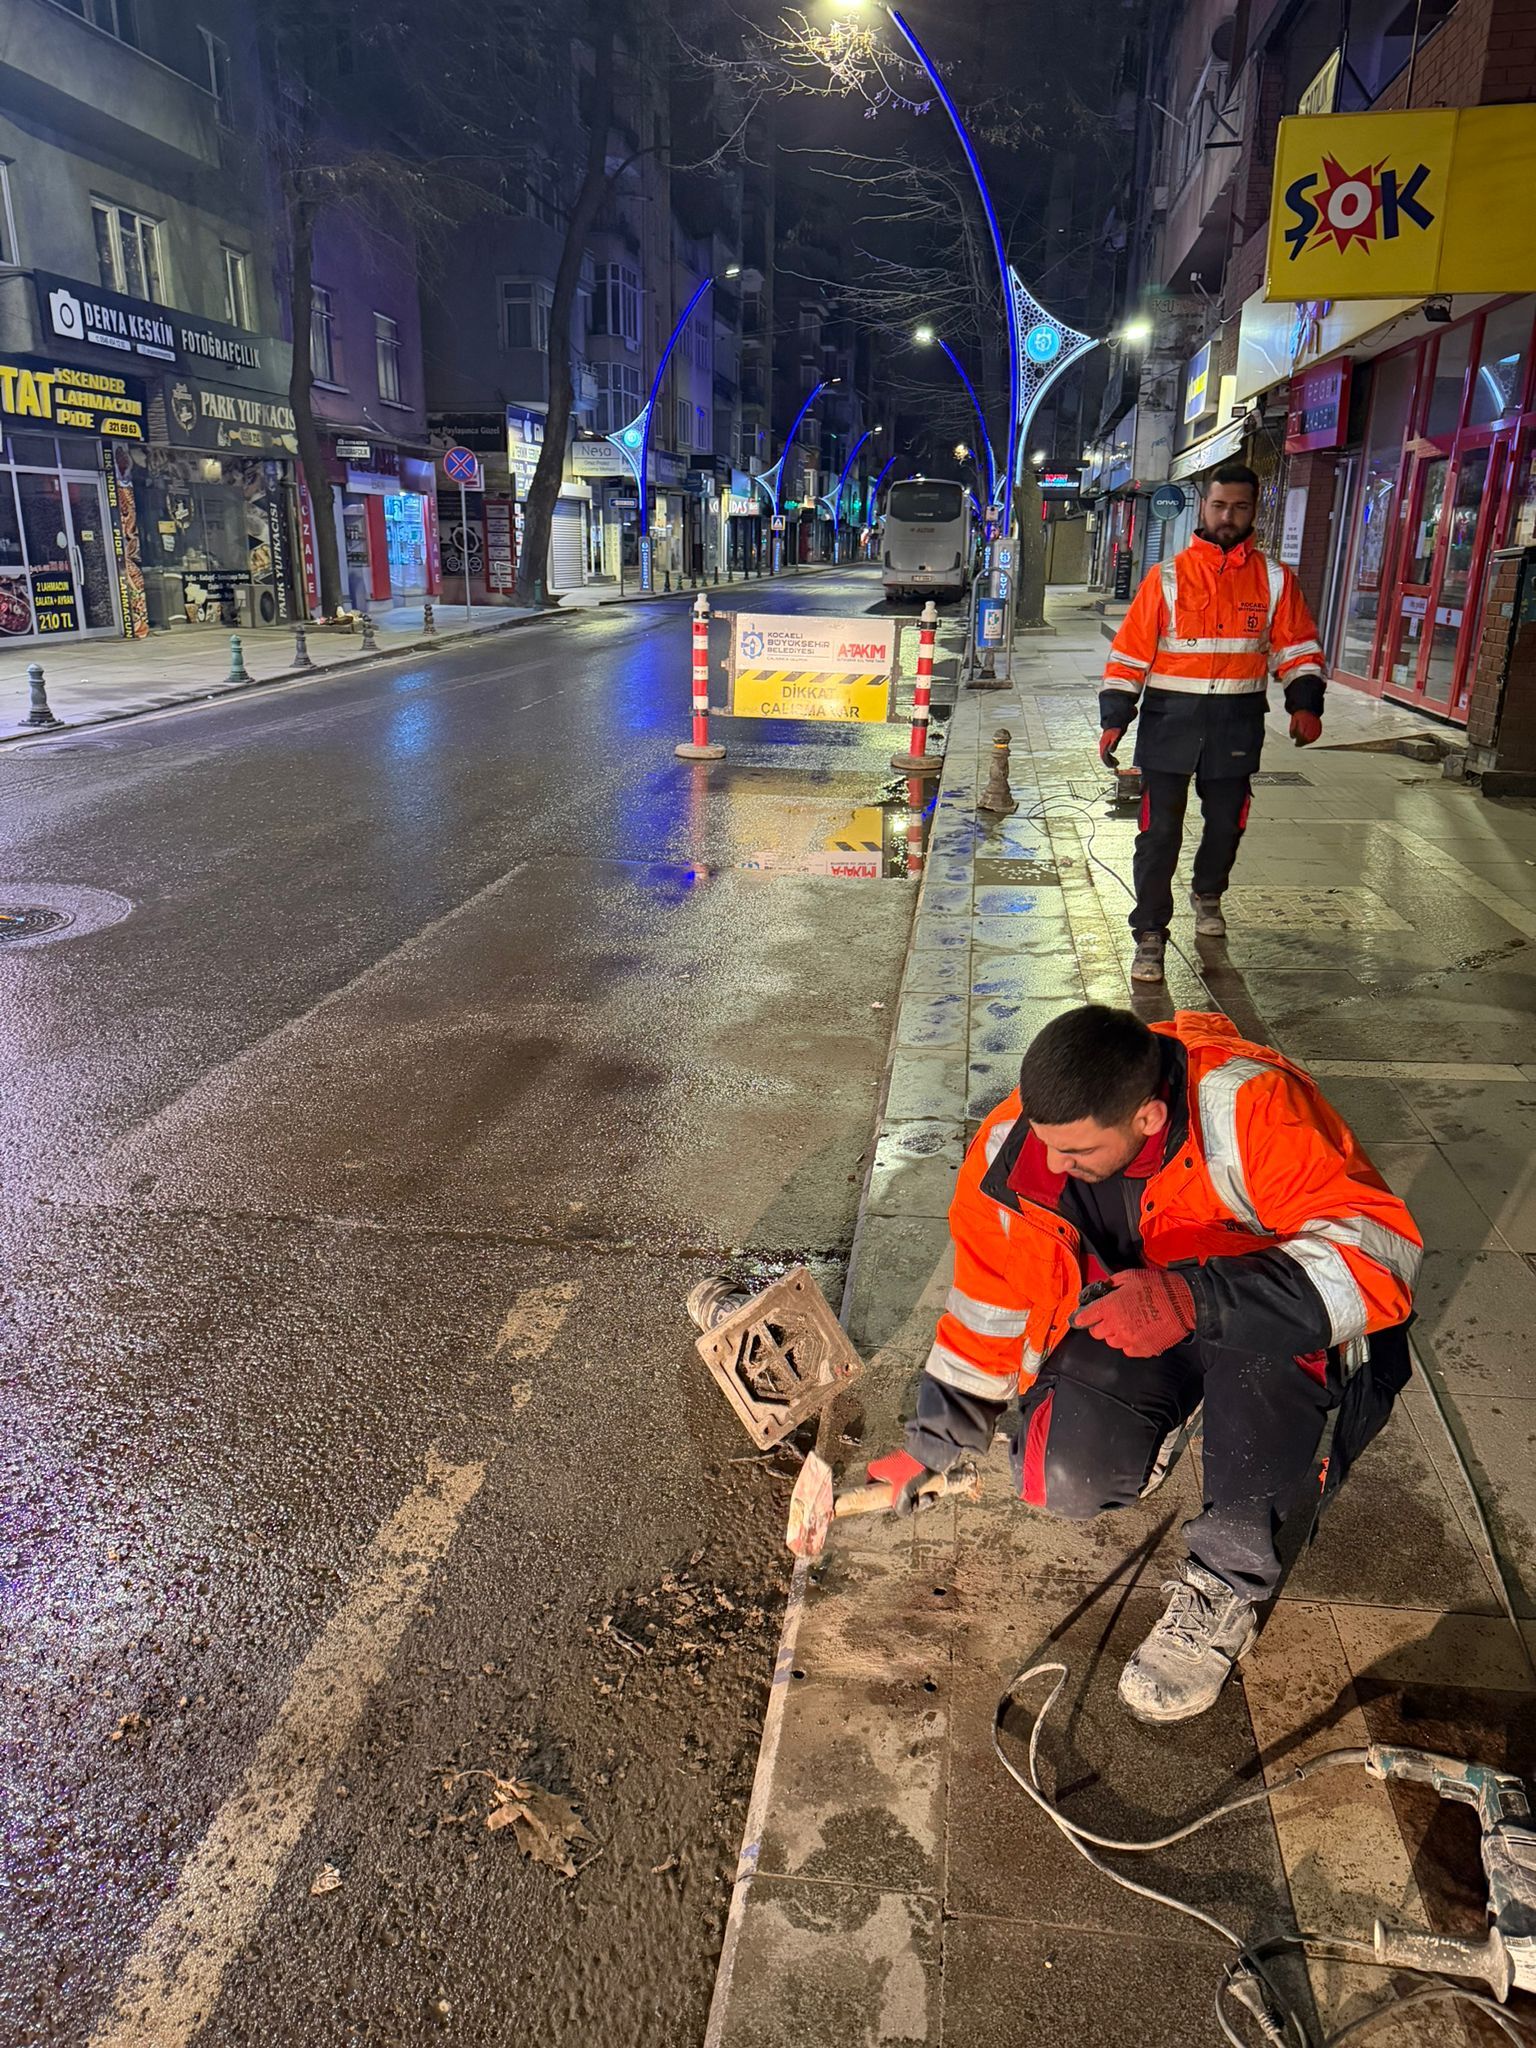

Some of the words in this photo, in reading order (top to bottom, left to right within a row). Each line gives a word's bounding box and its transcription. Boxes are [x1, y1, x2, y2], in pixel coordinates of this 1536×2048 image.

[1285, 163, 1435, 261] ŞOK
[84, 302, 128, 335] DERYA
[128, 314, 174, 347] KESKİN
[181, 329, 261, 369] FOTOĞRAFÇILIK
[0, 365, 55, 418] TAT
[54, 367, 126, 394] İSKENDER
[55, 388, 142, 416] LAHMACUN
[200, 391, 237, 420] PARK
[237, 399, 296, 430] YUFKACIS
[56, 408, 95, 428] PİDE
[109, 421, 120, 431] 321
[121, 423, 128, 433] 69
[129, 425, 137, 434] 63
[582, 446, 612, 457] Nesa
[270, 502, 283, 580] YUFKACISI
[301, 485, 315, 593] ECZANE
[430, 497, 440, 583] ECZANE
[36, 583, 41, 592] 2
[36, 596, 54, 606] SALATA
[276, 582, 288, 618] PARK
[120, 576, 132, 638] LAHMACUN
[39, 613, 59, 631] 210
[61, 612, 73, 628] TL
[767, 647, 815, 655] BELEDİYESİ
[768, 639, 830, 648] BÜYÜKŞEHİR
[838, 643, 886, 659] A-TAKIM
